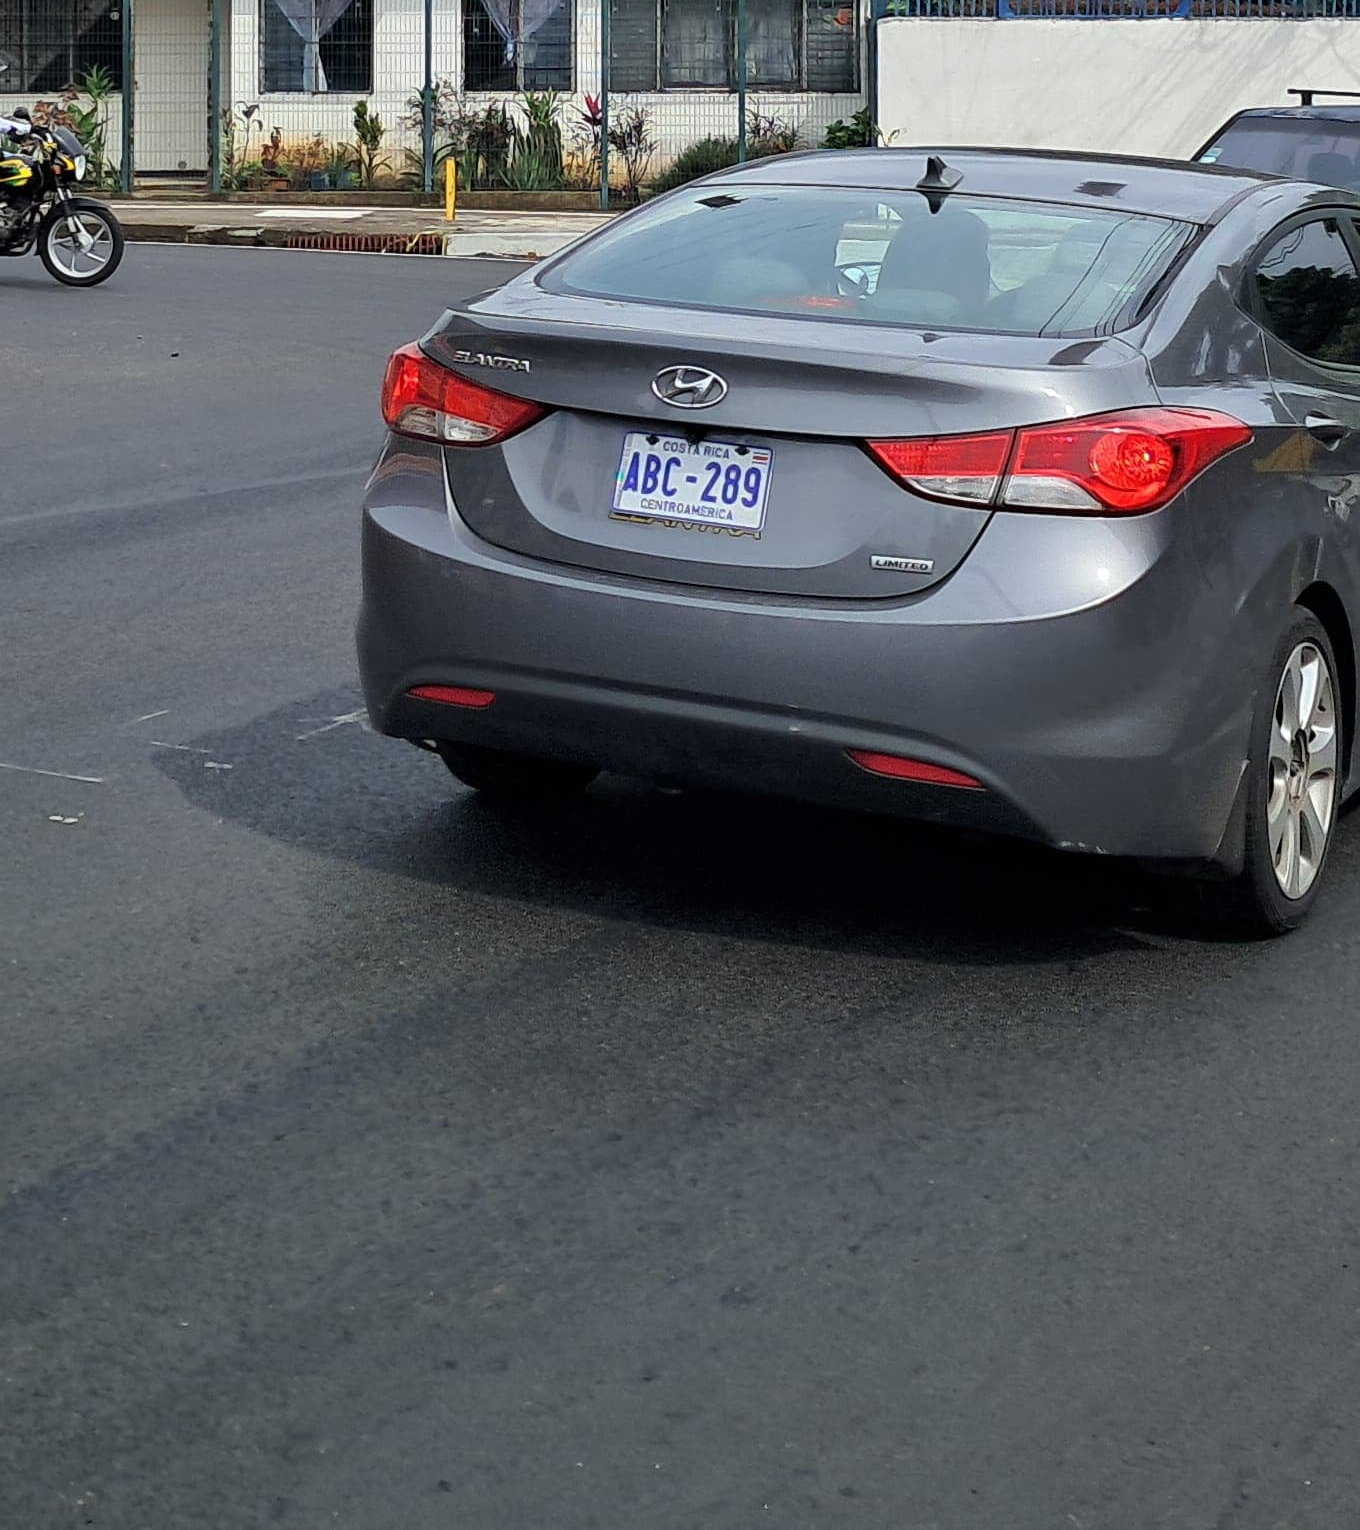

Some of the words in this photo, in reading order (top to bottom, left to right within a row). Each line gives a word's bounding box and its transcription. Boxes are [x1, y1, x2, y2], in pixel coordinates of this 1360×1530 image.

[663, 441, 700, 456] COSTA
[703, 445, 730, 460] RICA
[623, 451, 762, 509] ABC-289
[640, 498, 733, 521] CENTROAMERICA
[875, 559, 929, 571] LIMITED
